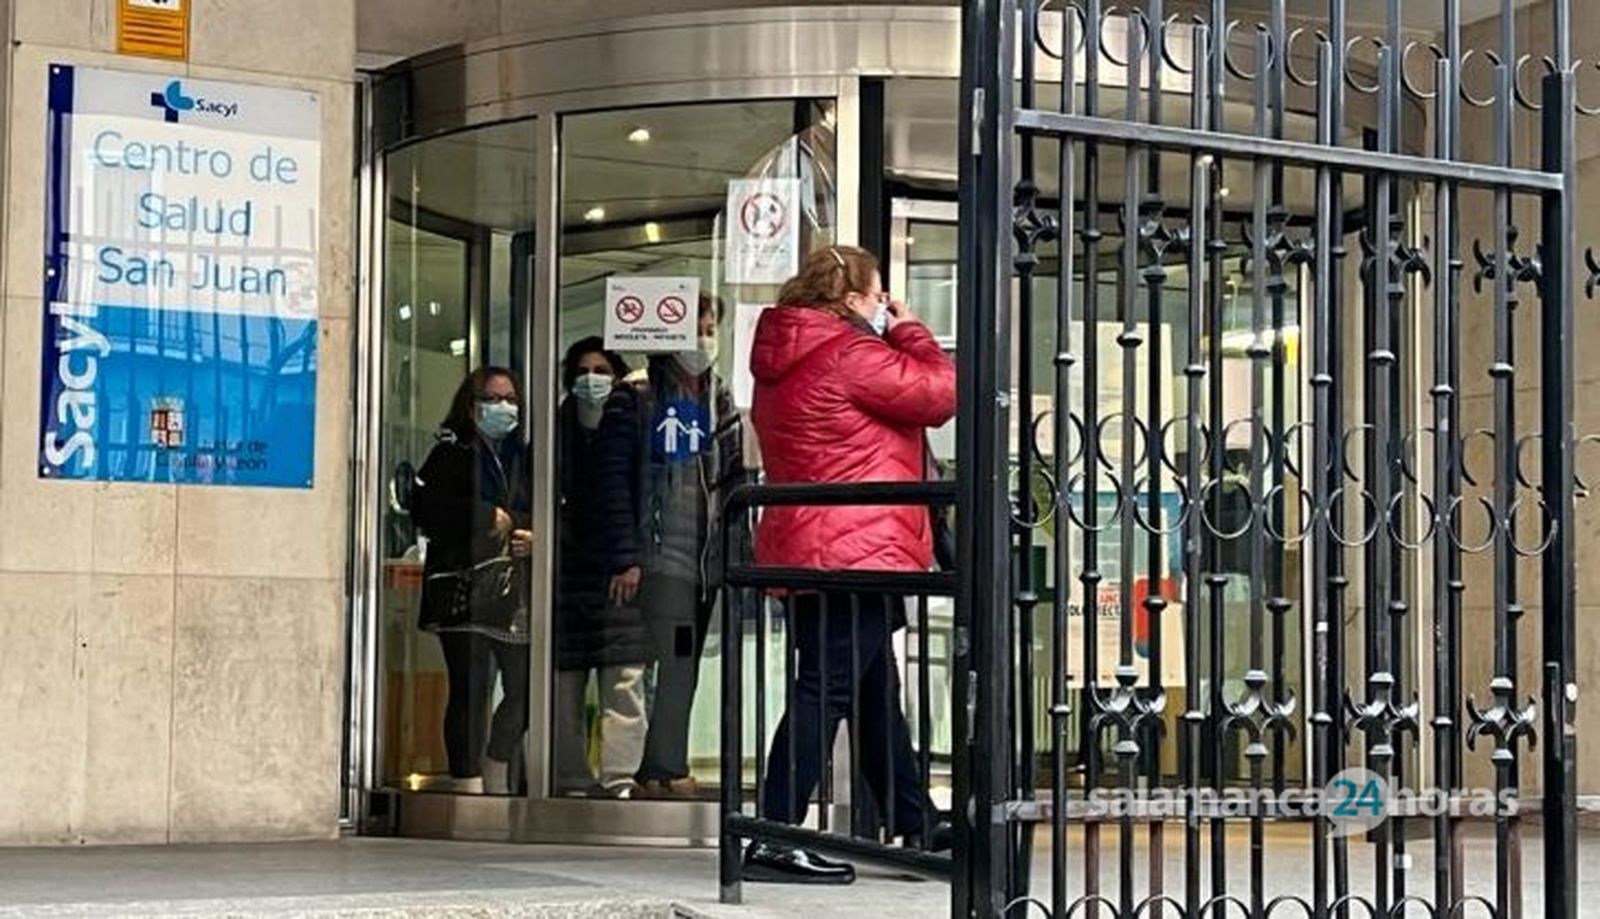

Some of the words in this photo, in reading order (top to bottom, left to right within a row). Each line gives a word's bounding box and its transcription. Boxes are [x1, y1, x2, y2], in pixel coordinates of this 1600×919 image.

[195, 98, 238, 117] Sacyl
[94, 131, 233, 179] Centro
[250, 147, 298, 185] de
[138, 193, 252, 237] Salud
[99, 247, 174, 288] San
[192, 254, 287, 296] Juan
[45, 301, 111, 468] Sacyl
